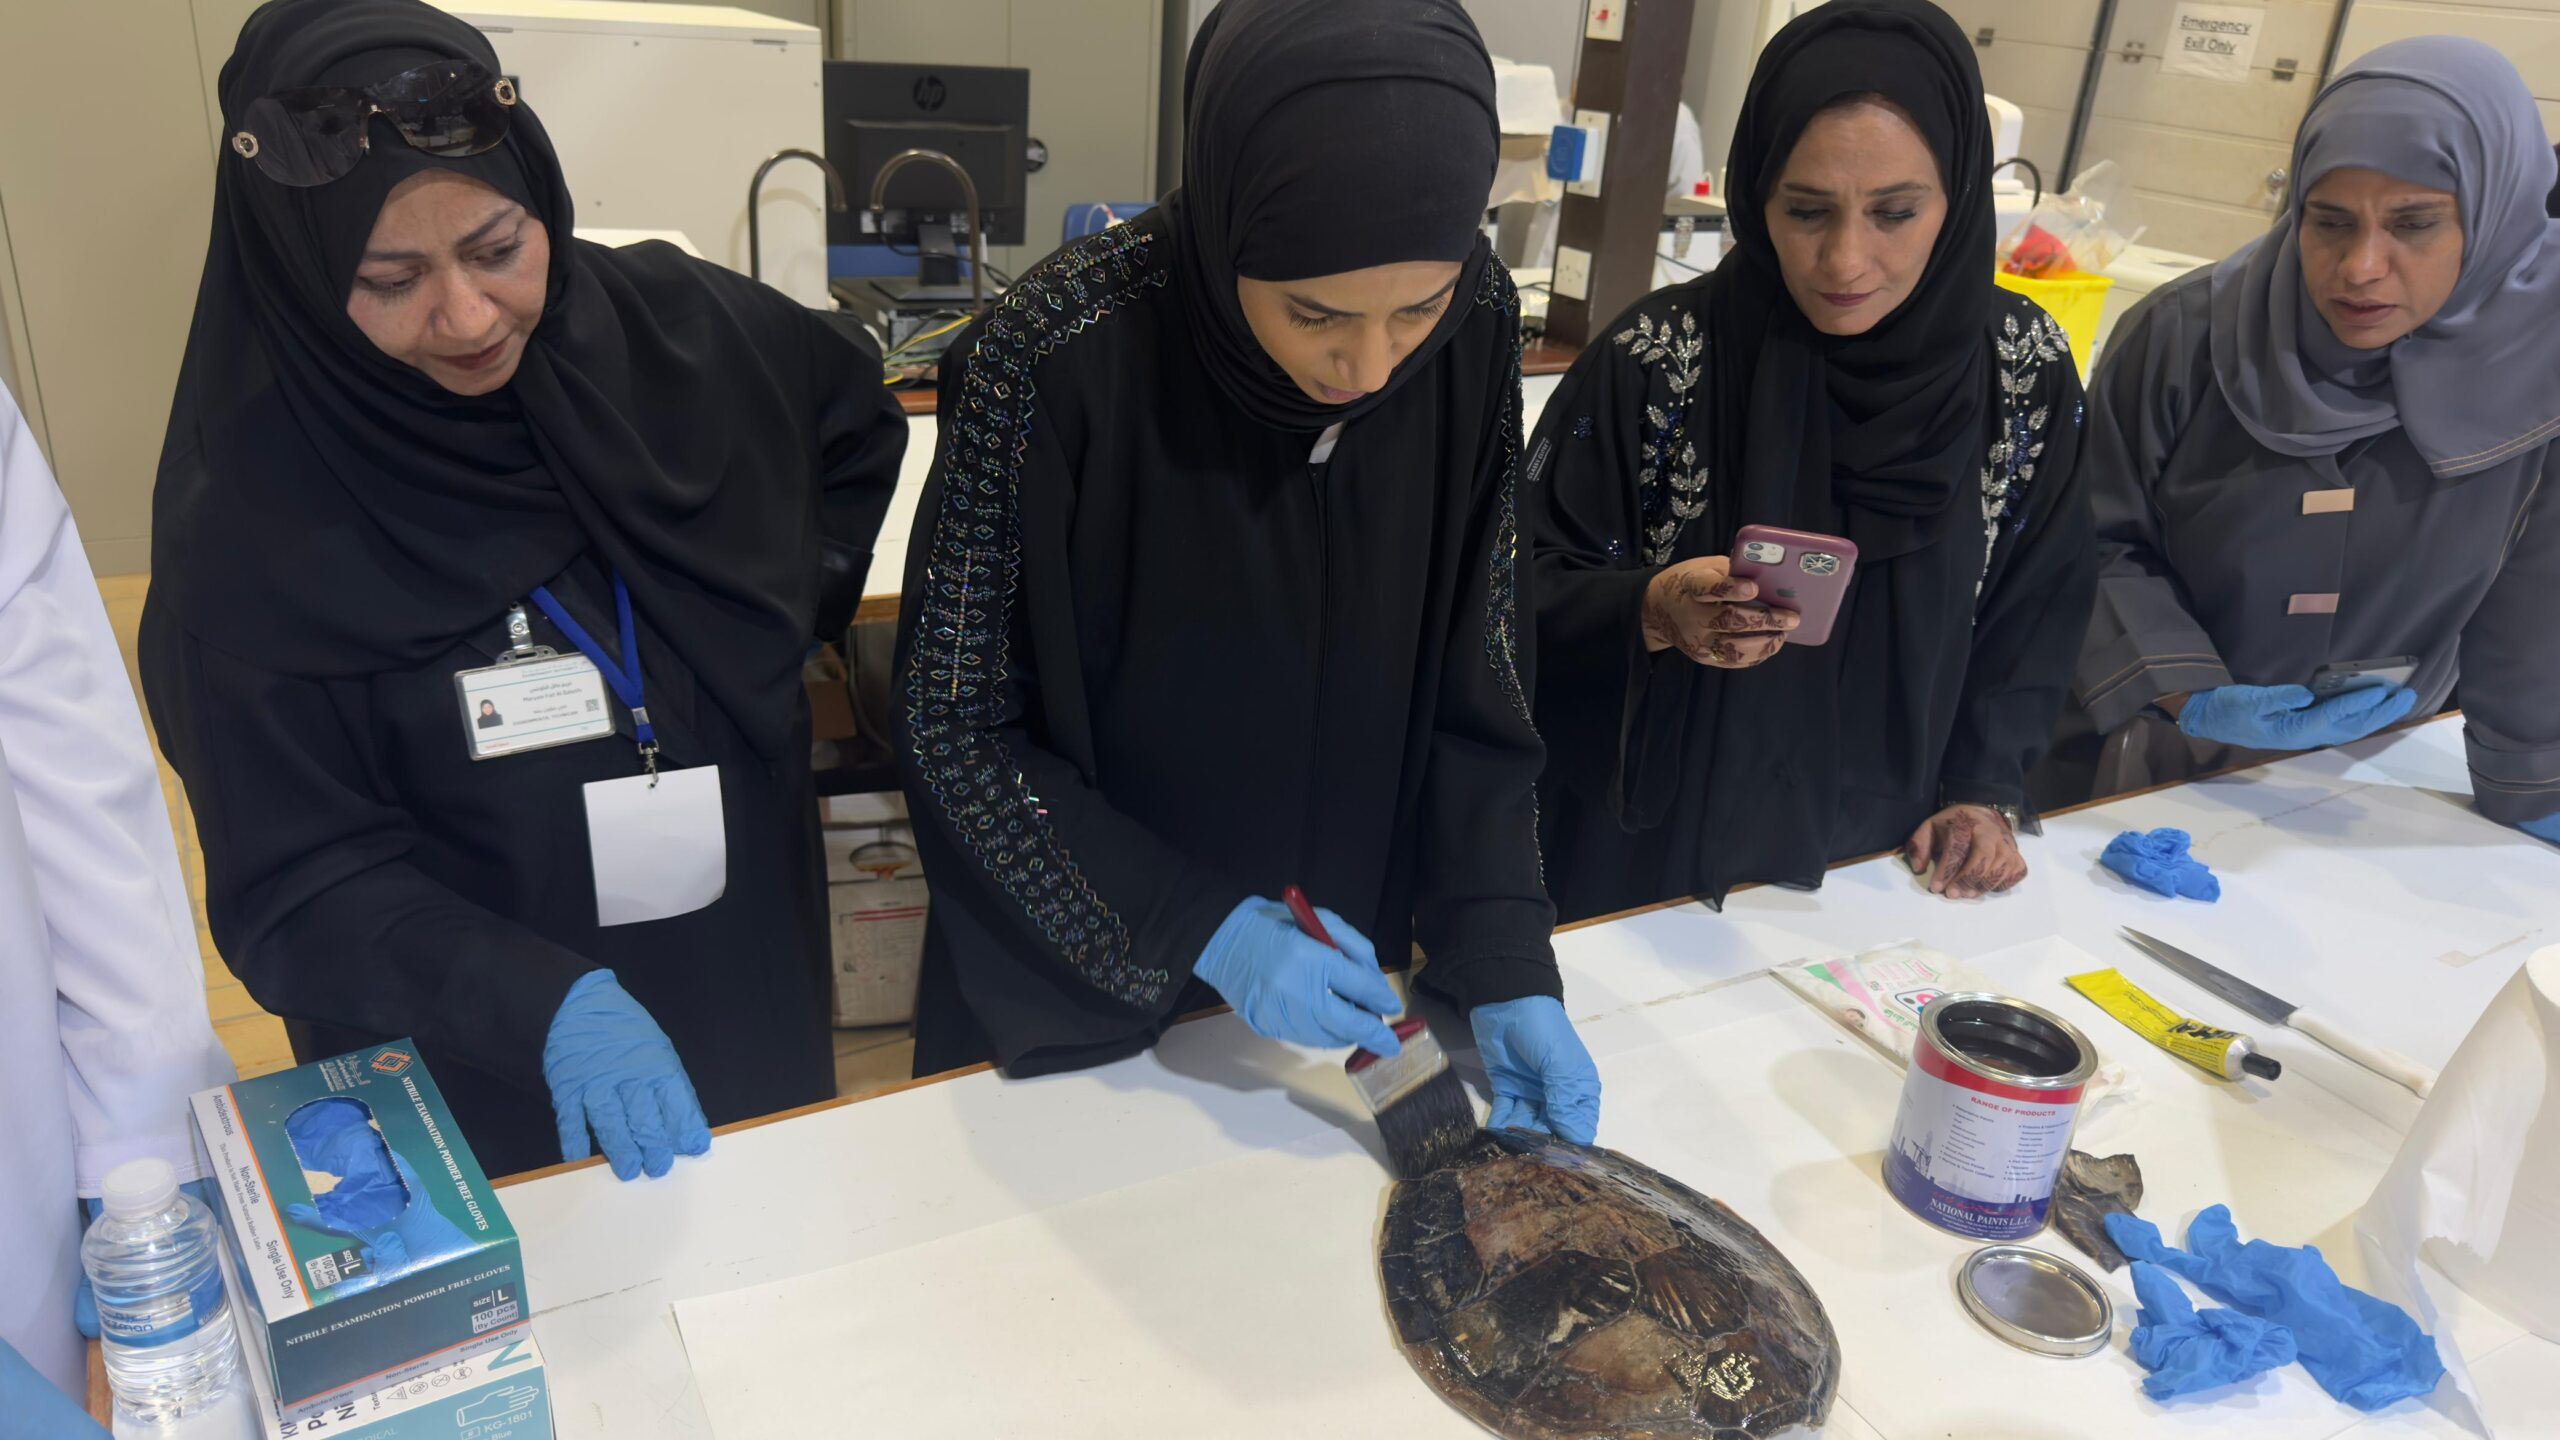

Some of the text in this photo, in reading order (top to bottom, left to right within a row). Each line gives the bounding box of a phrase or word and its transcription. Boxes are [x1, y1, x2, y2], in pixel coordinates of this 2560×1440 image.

[2181, 15, 2251, 35] Emergency
[2184, 37, 2237, 55] Exit Only
[213, 1094, 234, 1137] Ambidextrous
[1970, 1096, 2057, 1117] RANGE OF PRODUCTS
[401, 1076, 489, 1231] NITRILE EXAMINATION POWDER FREE GLOVES
[239, 1166, 260, 1205] Non-Sterile
[1930, 1198, 1975, 1222] NATIONAL
[1976, 1215, 2009, 1226] PAINTS
[266, 1240, 295, 1300] Single Use Only
[322, 1256, 337, 1283] 100 pcs
[343, 1250, 360, 1275] SIZE L
[286, 1264, 511, 1347] NITRILE EXAMINATION POWDER FREE GLOVES
[473, 1289, 509, 1308] SIZE L
[473, 1303, 516, 1322] 100 pcs
[460, 1329, 518, 1352] Single Use Only
[385, 1361, 429, 1380] Non-Sterile
[484, 1409, 533, 1433] KG-1801
